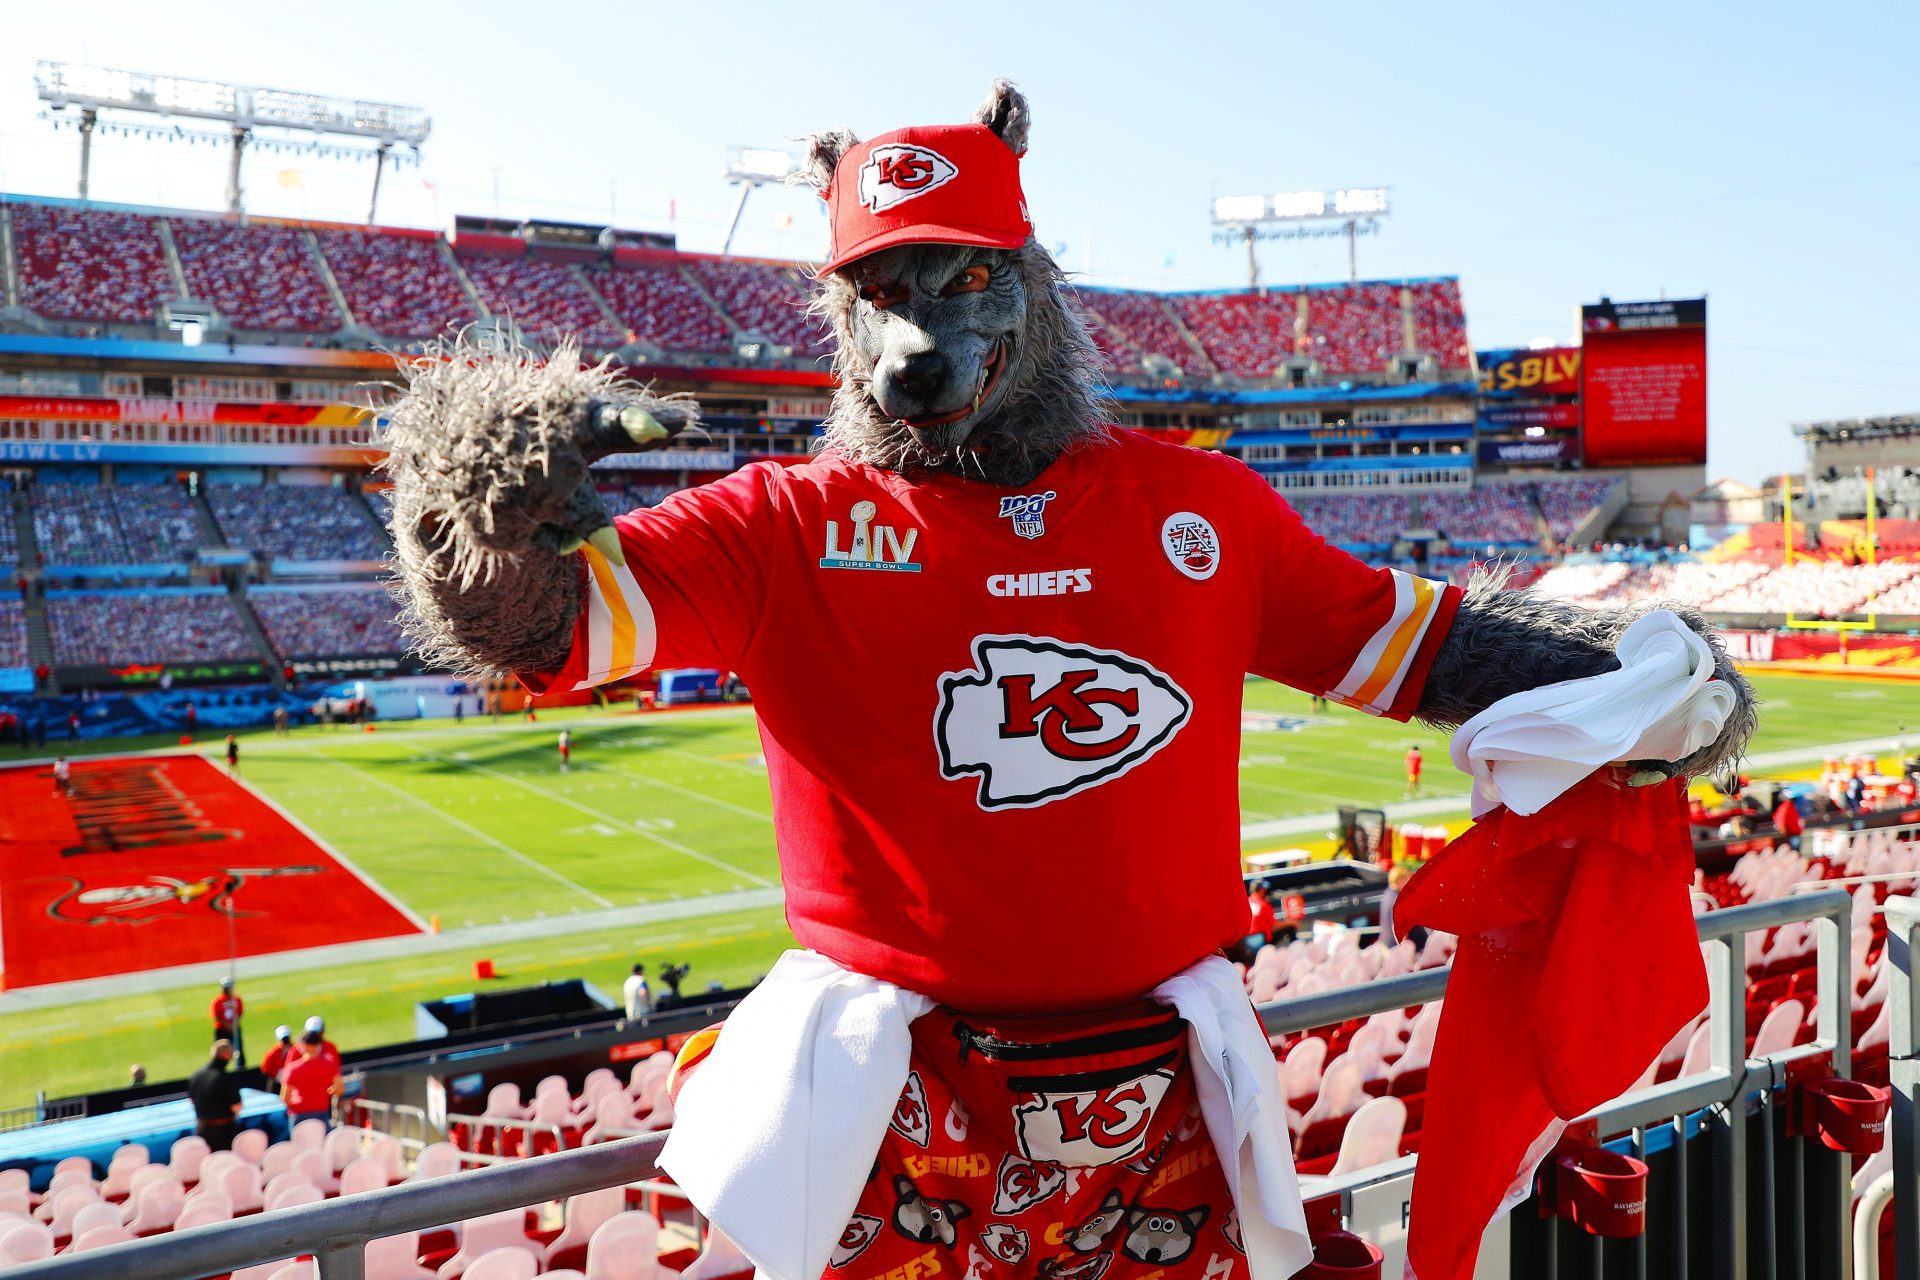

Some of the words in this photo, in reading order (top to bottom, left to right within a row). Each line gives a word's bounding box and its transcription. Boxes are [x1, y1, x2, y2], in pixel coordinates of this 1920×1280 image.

[877, 153, 934, 189] KC
[74, 444, 102, 460] LV
[1000, 495, 1046, 515] 100
[1018, 522, 1040, 535] NFL
[838, 560, 872, 569] SUPER
[875, 562, 904, 571] BOWL
[986, 568, 1093, 597] CHIEFS
[997, 669, 1141, 762] KC
[1052, 1081, 1152, 1149] KC
[902, 1152, 991, 1180] CHIEFS
